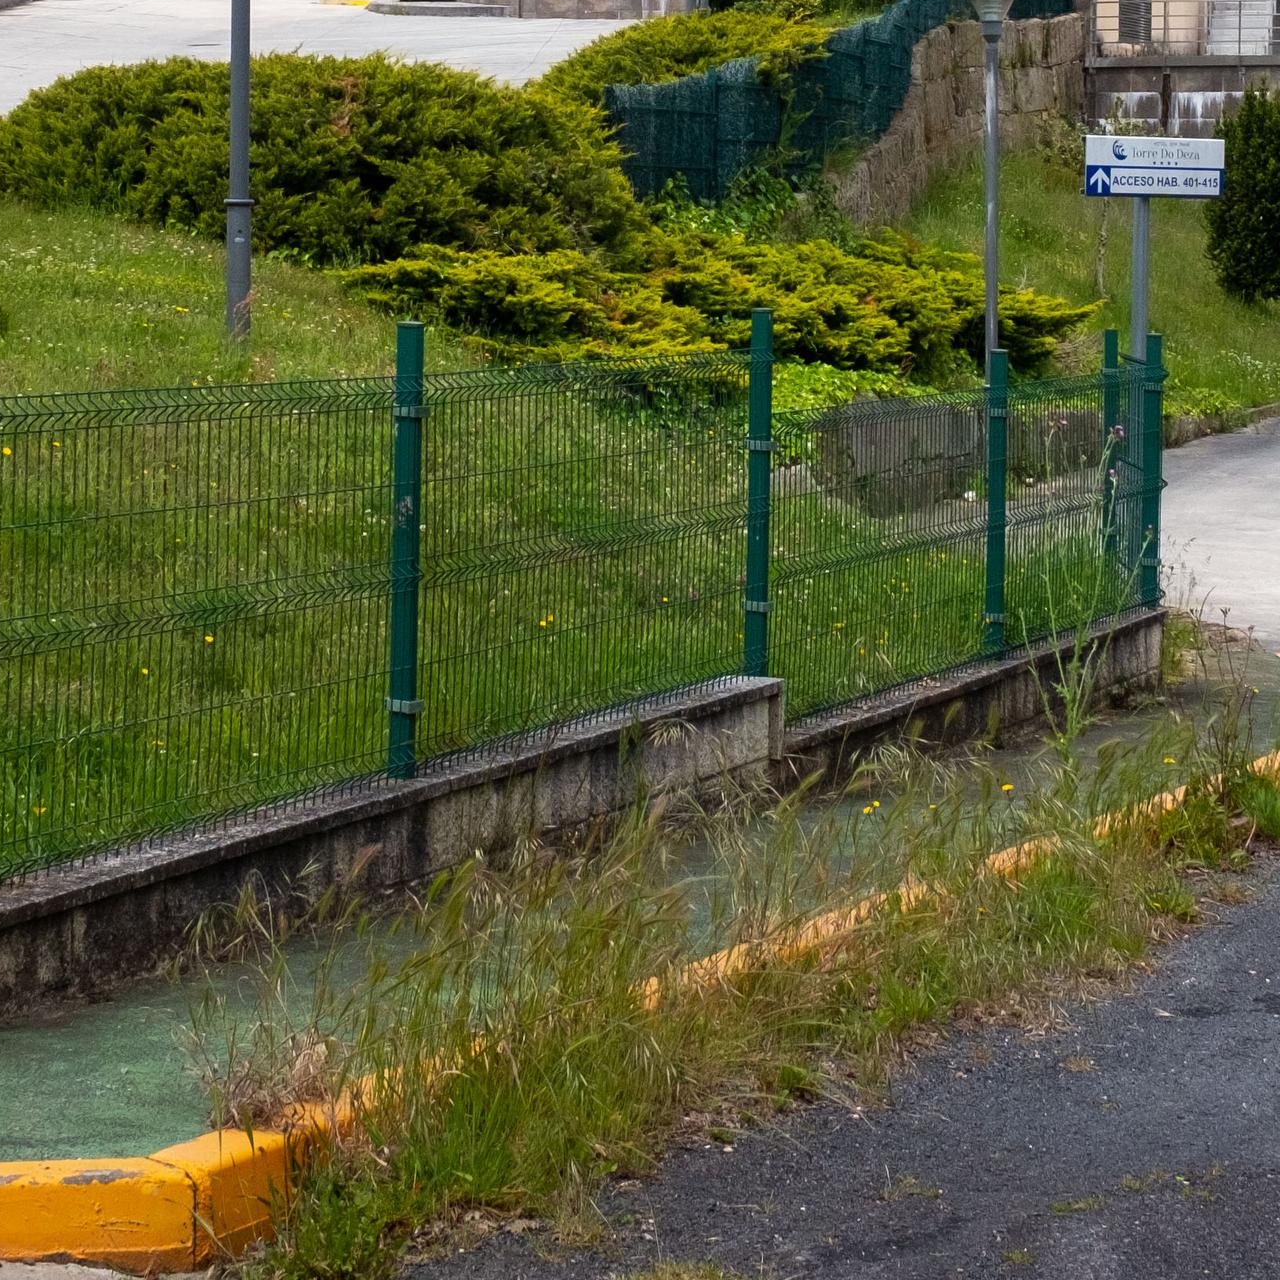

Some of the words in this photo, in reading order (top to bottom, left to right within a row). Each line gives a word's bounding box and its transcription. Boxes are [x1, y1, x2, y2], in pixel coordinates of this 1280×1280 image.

[1132, 147, 1158, 159] Torre
[1160, 148, 1174, 159] Do
[1176, 149, 1200, 160] Deza
[1112, 175, 1155, 187] ACCESO
[1156, 176, 1180, 188] HAB.
[1182, 177, 1218, 189] 401-415
